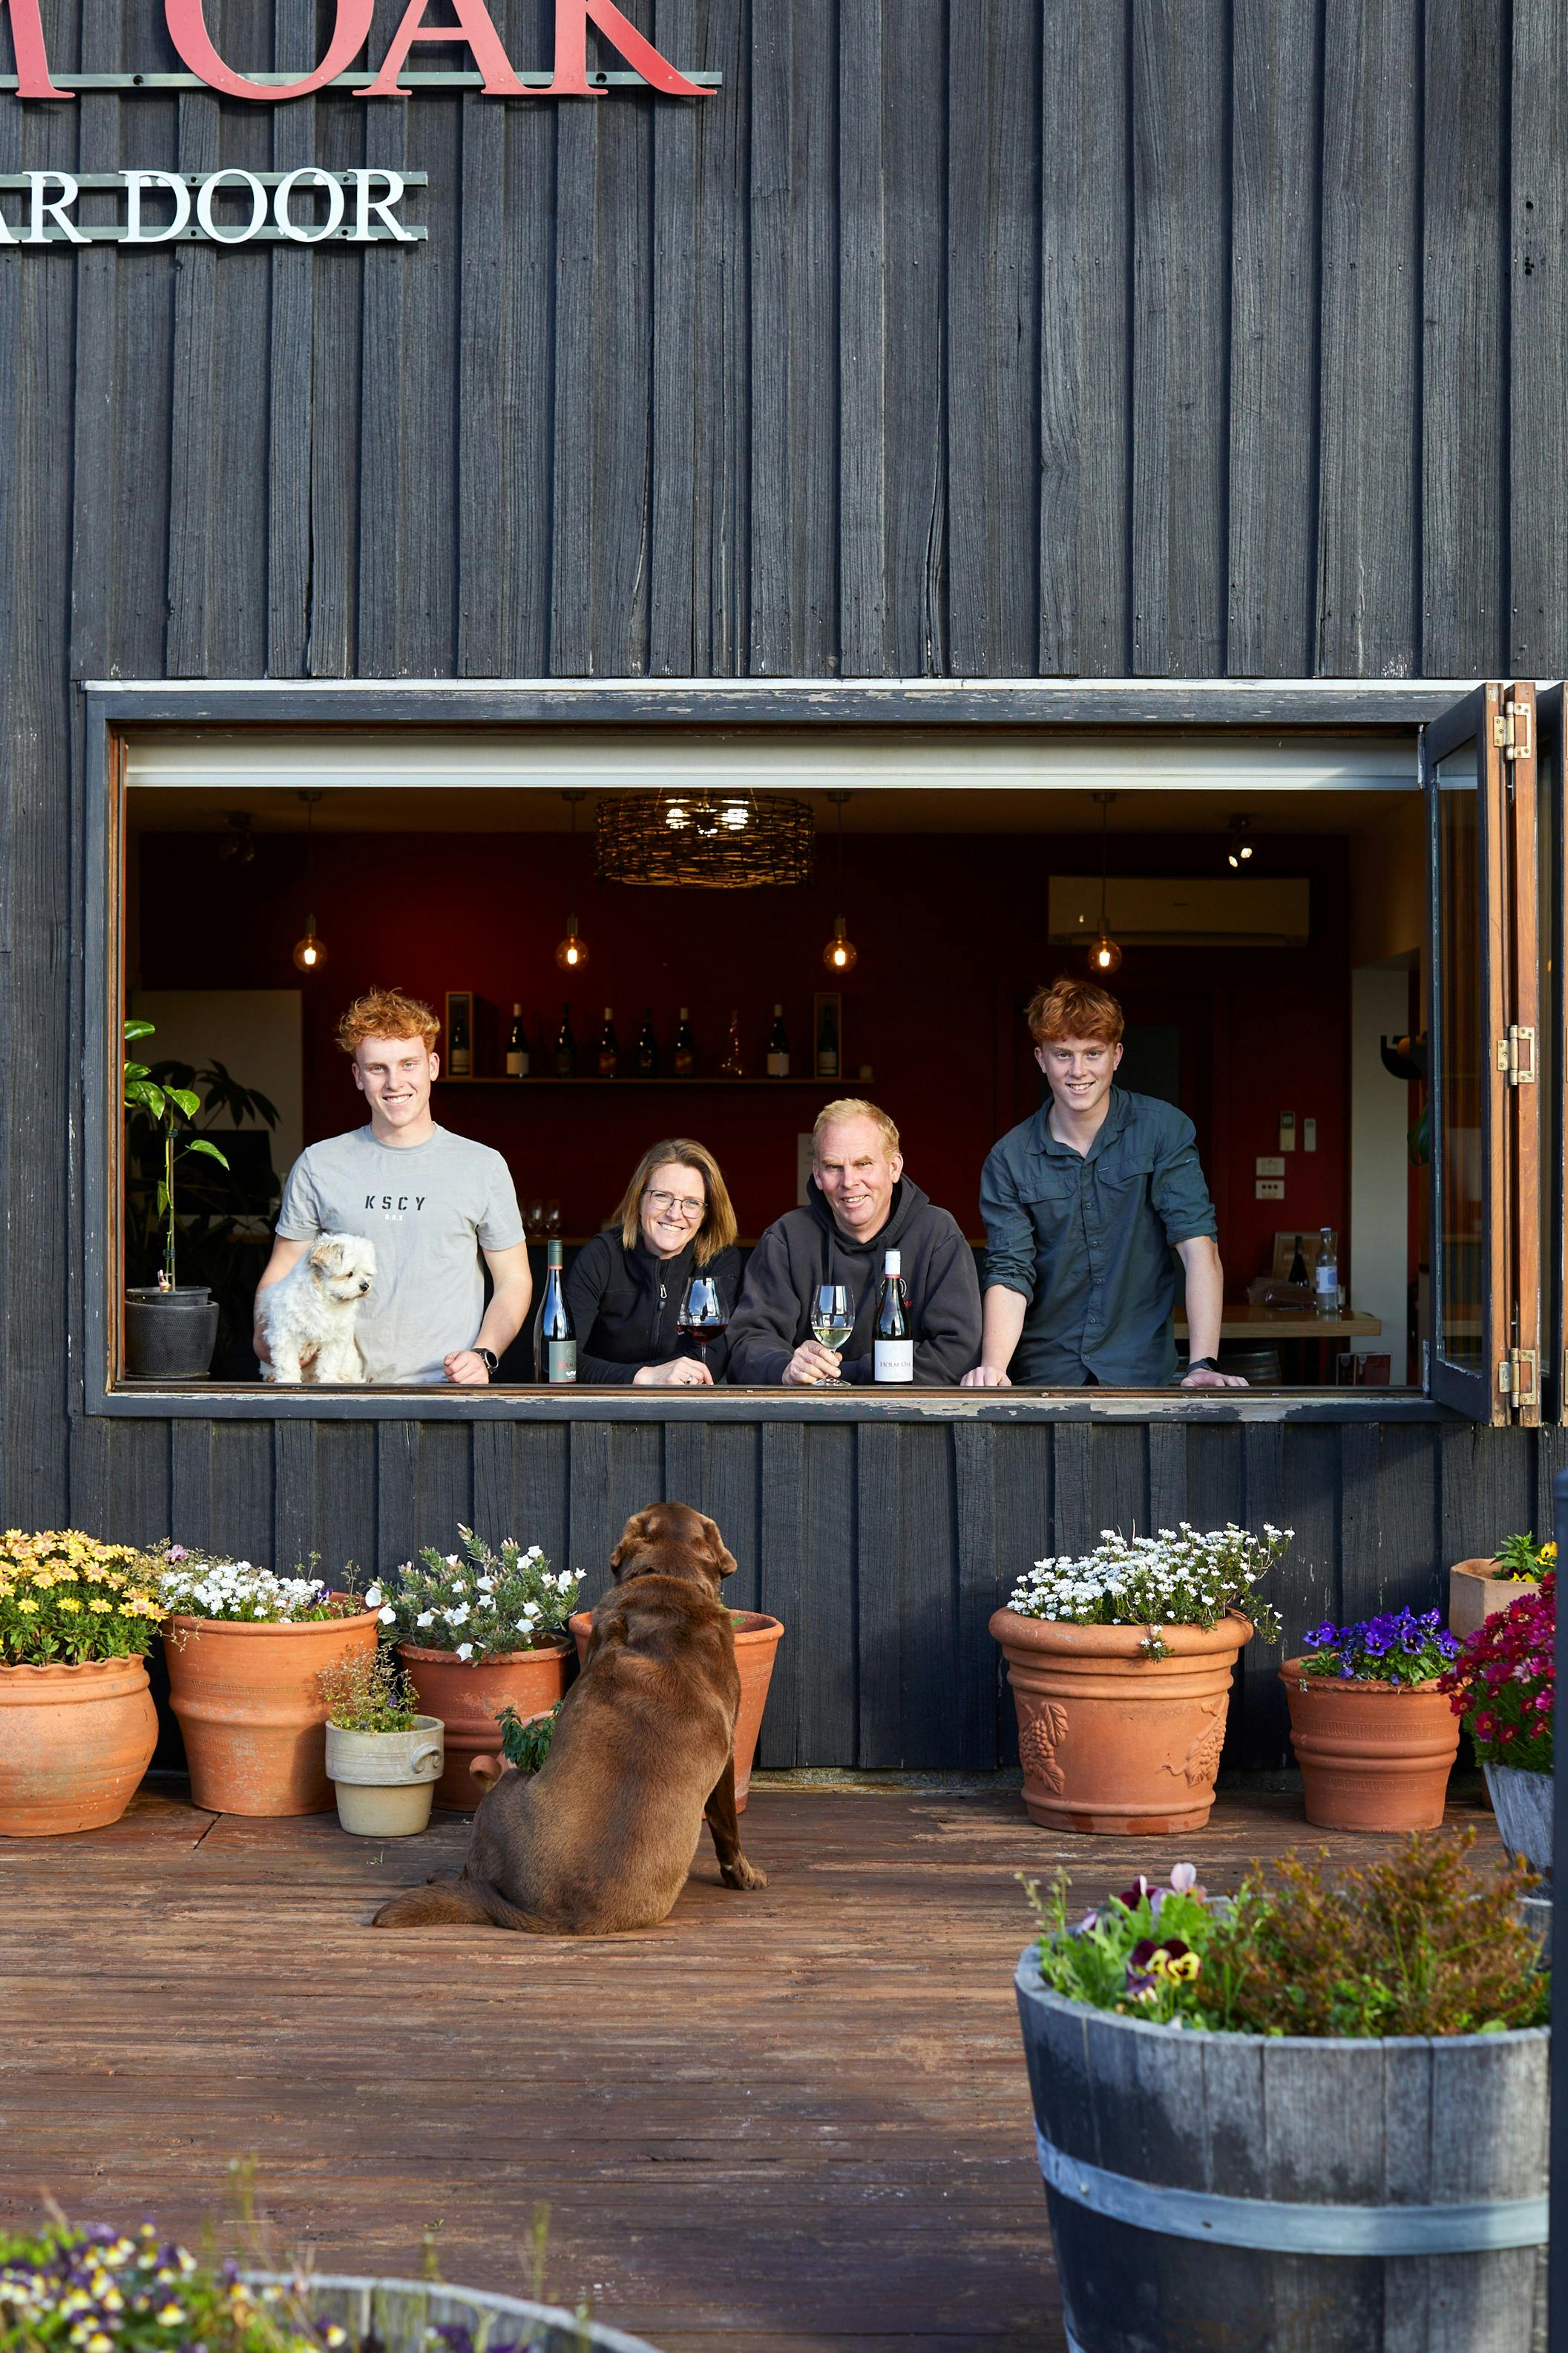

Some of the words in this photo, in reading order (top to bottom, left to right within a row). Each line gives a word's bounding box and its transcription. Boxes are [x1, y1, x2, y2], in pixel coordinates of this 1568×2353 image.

[165, 0, 718, 99] OAK
[0, 171, 93, 243] R
[119, 168, 418, 243] DOOR
[365, 1195, 425, 1211] KSCY
